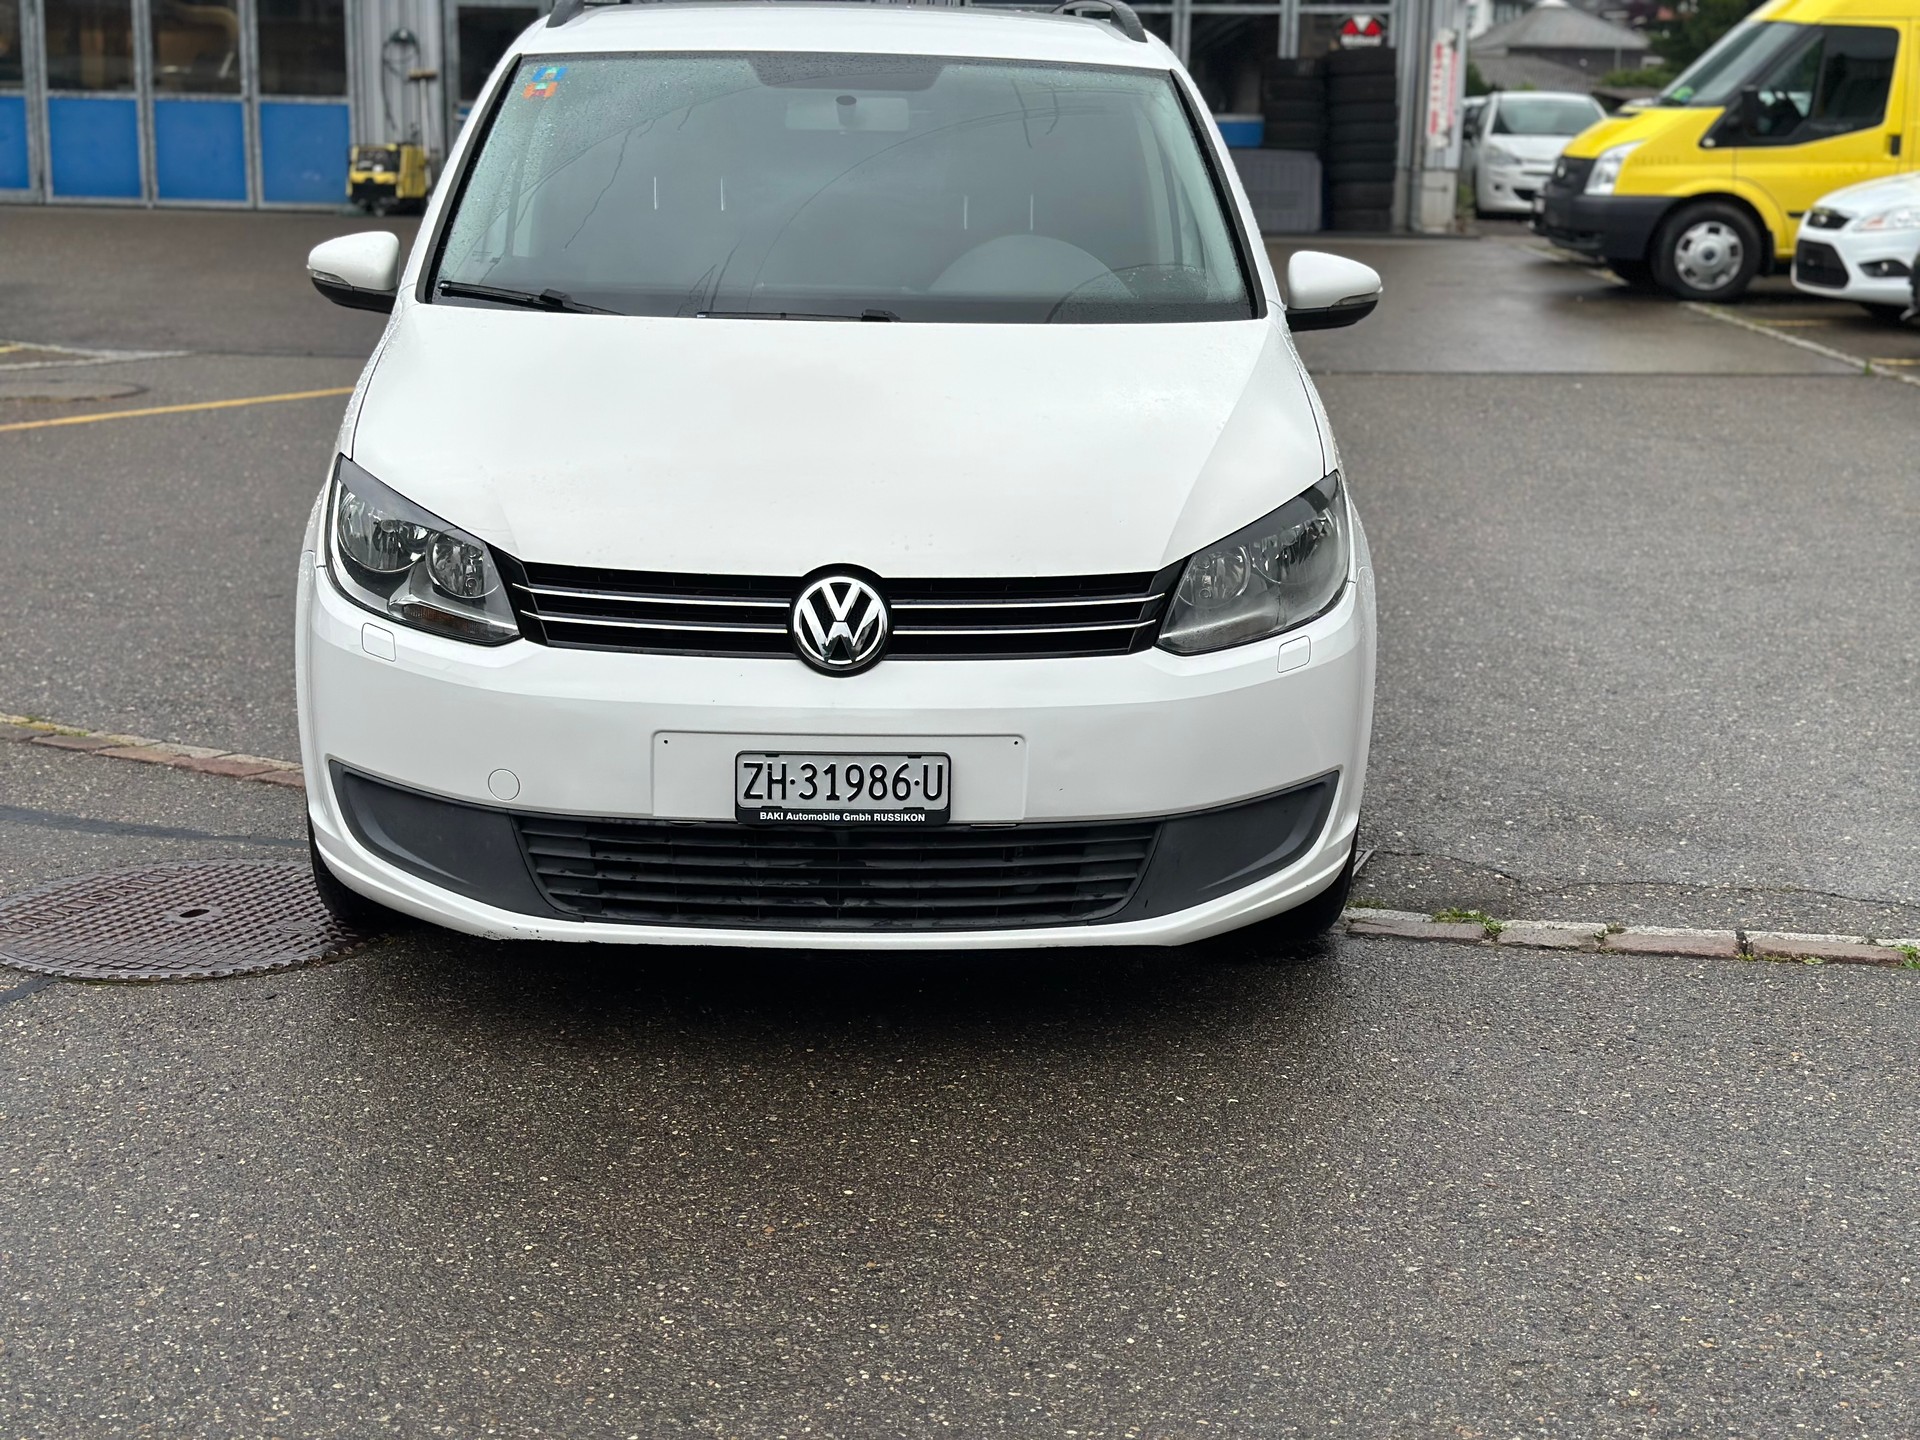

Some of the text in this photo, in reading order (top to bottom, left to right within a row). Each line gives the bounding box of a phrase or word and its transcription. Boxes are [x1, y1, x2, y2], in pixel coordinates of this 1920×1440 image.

[795, 577, 886, 664] VW
[760, 811, 925, 822] BAKI Automobile Gmbh RUSSIKON
